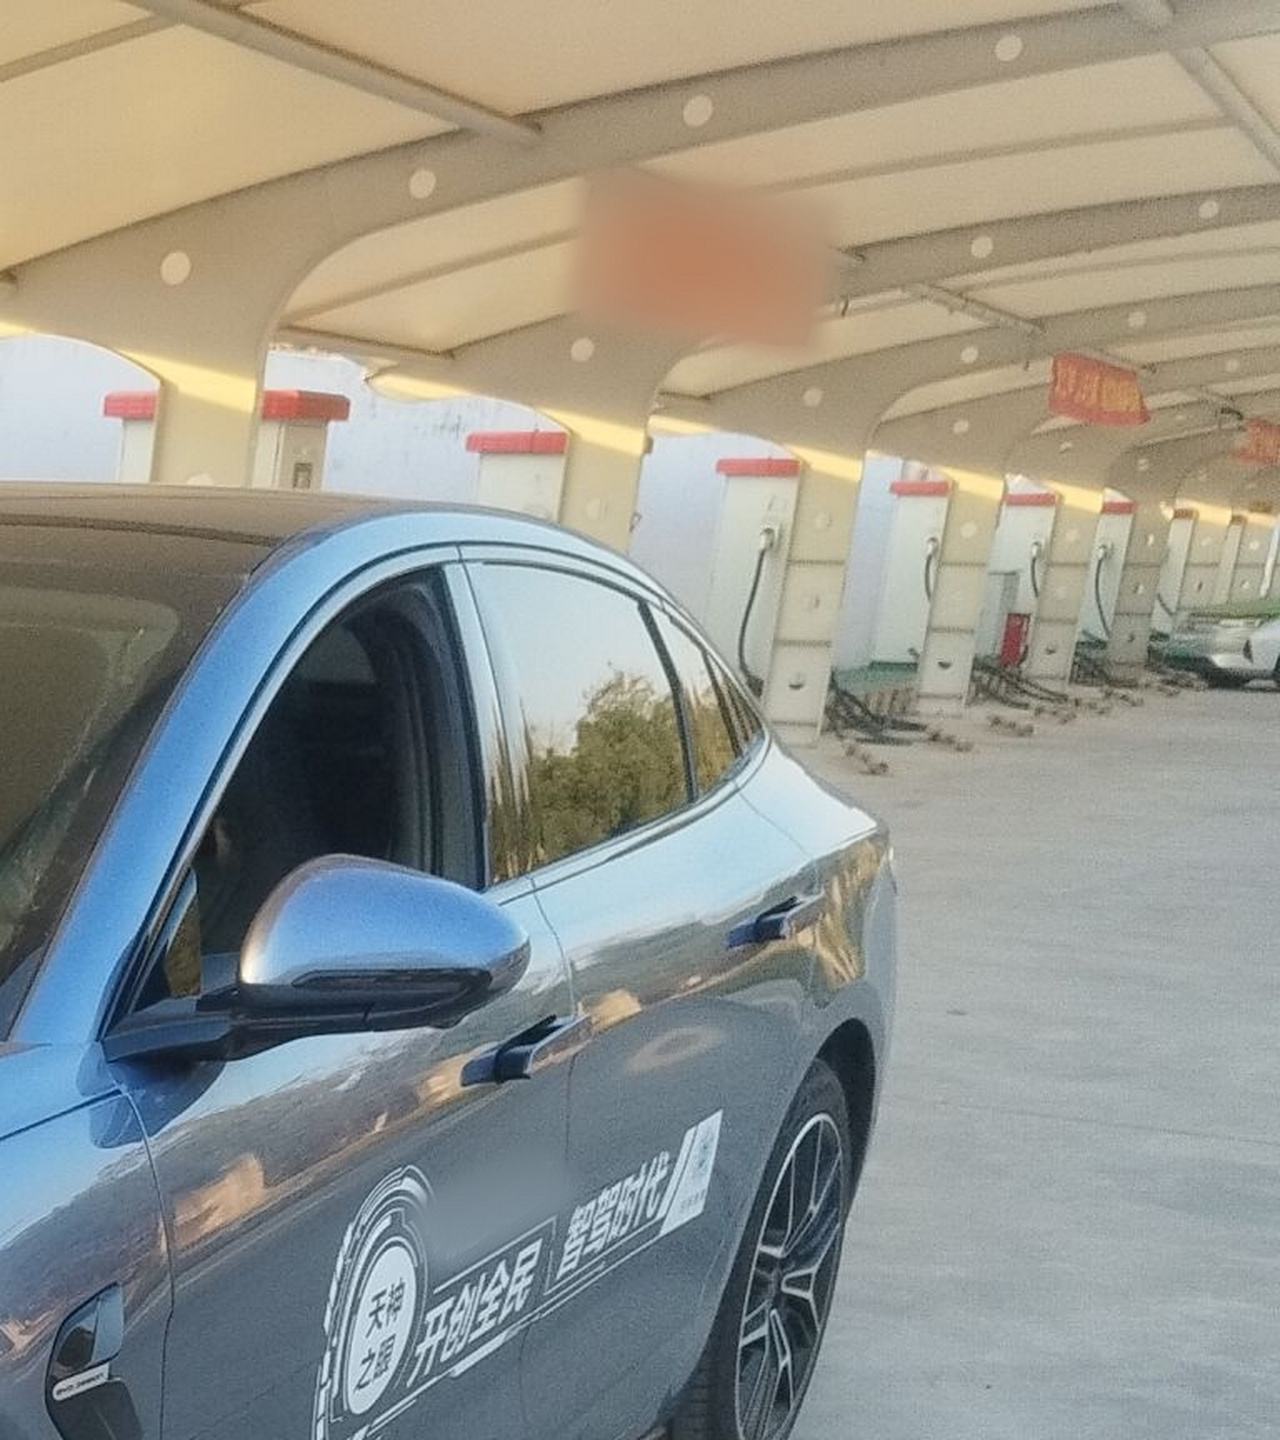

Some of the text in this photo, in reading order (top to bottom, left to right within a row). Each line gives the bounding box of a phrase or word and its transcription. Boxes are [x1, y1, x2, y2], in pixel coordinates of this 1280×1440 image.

[365, 1277, 406, 1338] 天神
[406, 1238, 543, 1387] 开创全民
[354, 1333, 397, 1396] 之眼
